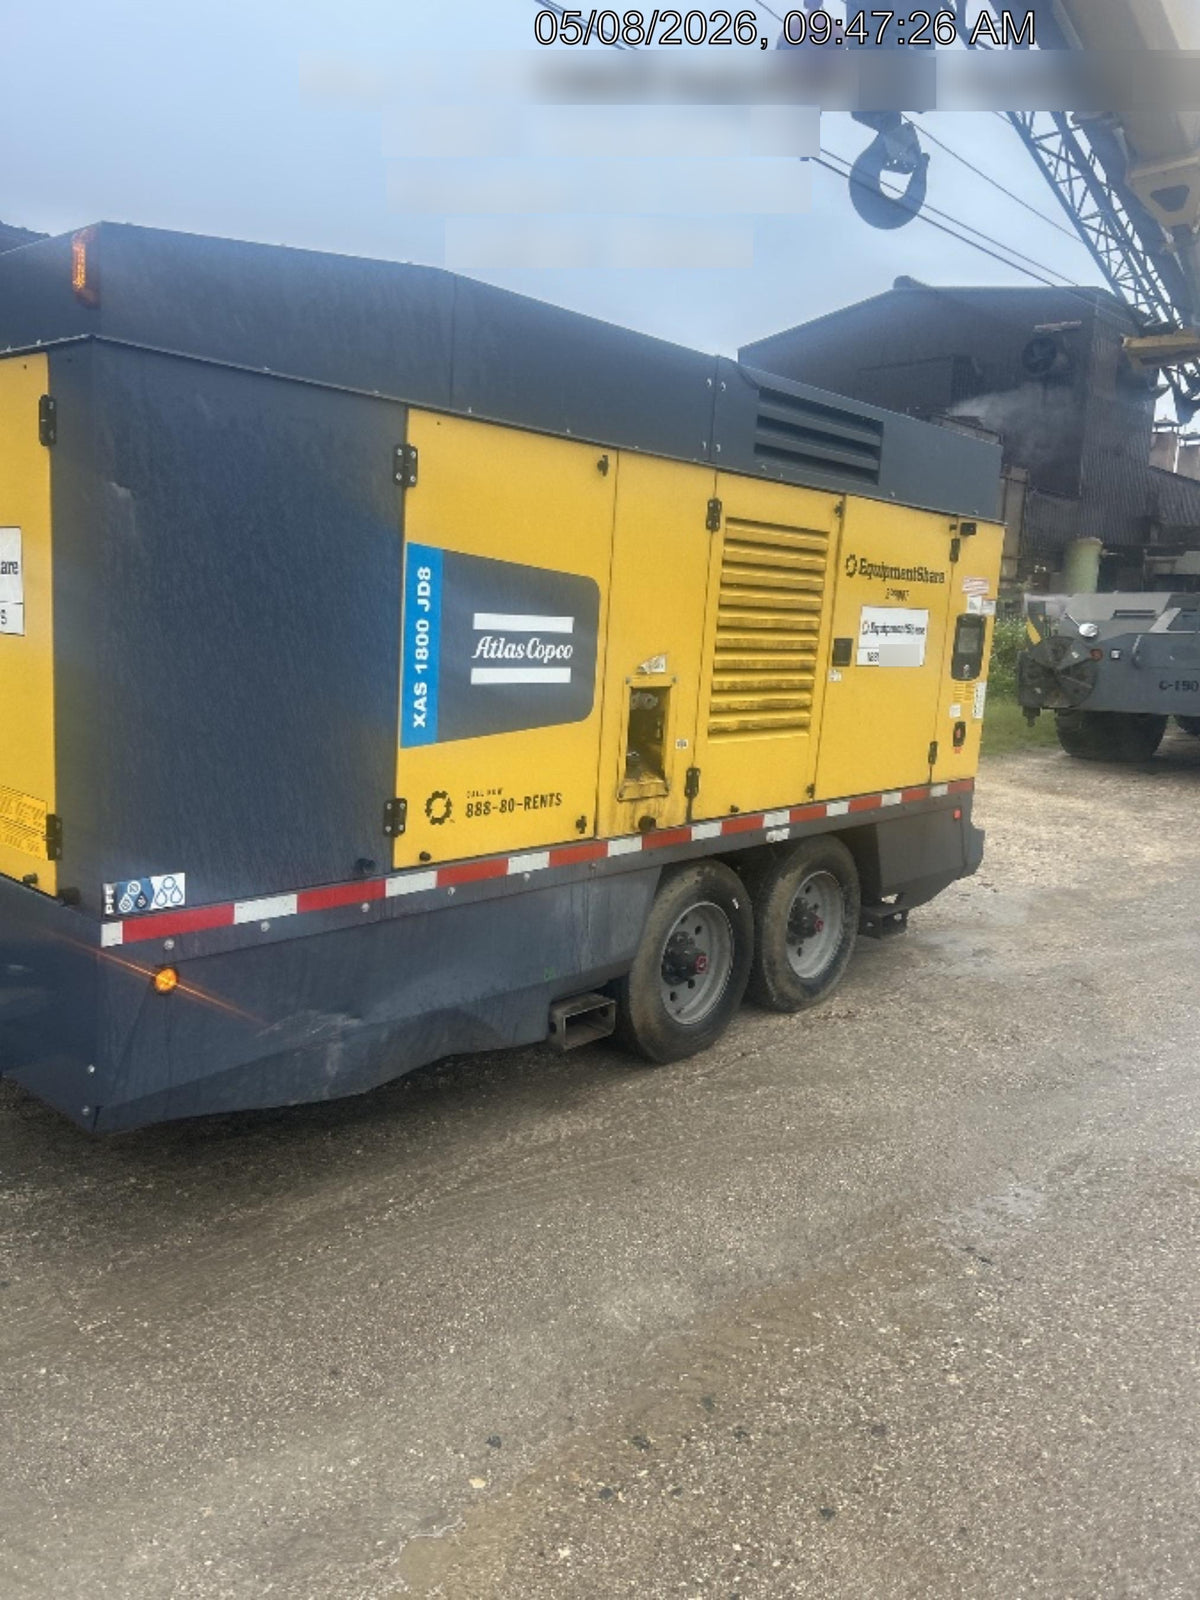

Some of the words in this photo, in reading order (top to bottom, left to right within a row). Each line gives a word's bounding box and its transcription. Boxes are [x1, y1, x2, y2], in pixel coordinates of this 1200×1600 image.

[417, 566, 431, 612] JD8
[859, 557, 945, 584] EquipmentShare
[415, 618, 430, 674] 1800
[471, 635, 525, 659] Atlas
[526, 637, 573, 664] Copco
[413, 682, 428, 728] XAS
[465, 792, 562, 818] 888-80-RENTS
